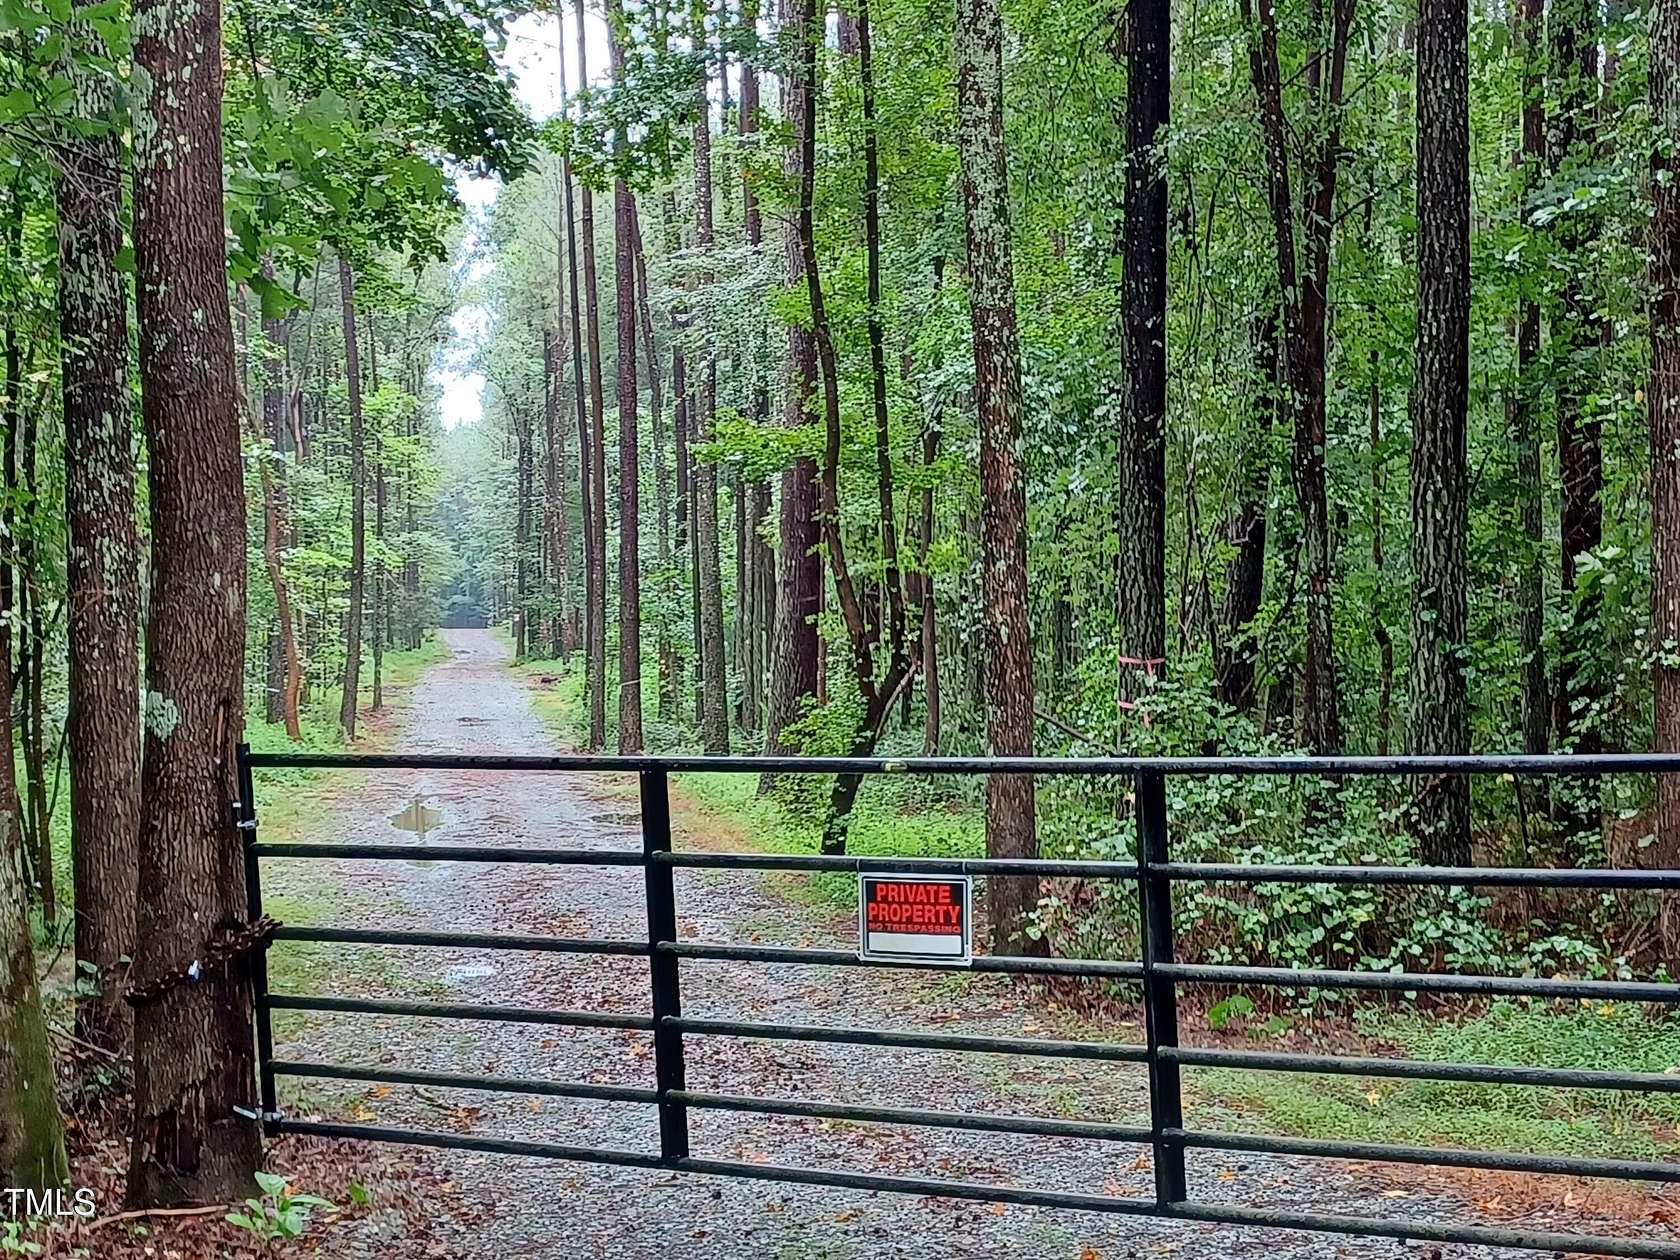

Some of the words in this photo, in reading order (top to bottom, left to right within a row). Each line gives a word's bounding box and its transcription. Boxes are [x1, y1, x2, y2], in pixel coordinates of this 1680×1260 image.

[876, 884, 951, 903] PRIVATE
[868, 902, 960, 923] PROPERTY
[868, 922, 883, 931] NO
[885, 923, 961, 933] TRESPASSING
